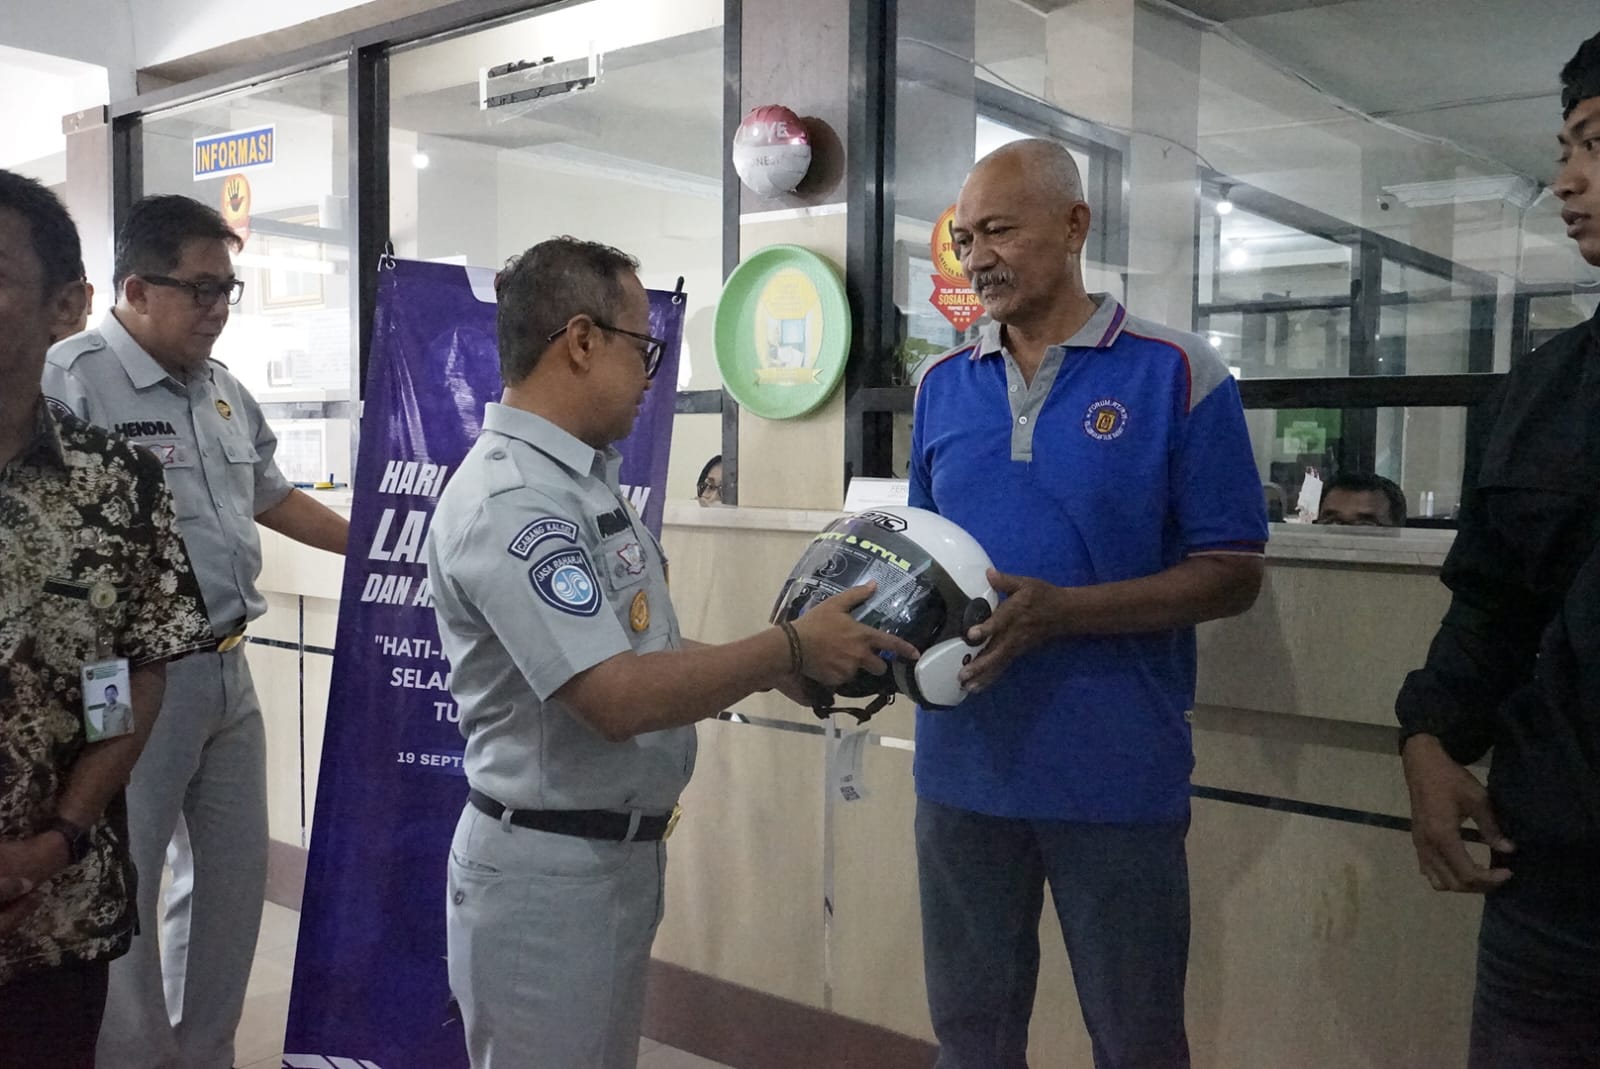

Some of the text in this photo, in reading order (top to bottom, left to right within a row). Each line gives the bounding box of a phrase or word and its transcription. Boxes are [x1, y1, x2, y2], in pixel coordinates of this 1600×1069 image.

[197, 133, 272, 172] INFORMASI
[1088, 399, 1111, 413] FORUM
[115, 421, 176, 438] HENDRA
[378, 460, 448, 497] HARI
[517, 525, 545, 551] CABANG
[859, 540, 911, 572] STYLE
[536, 564, 555, 582] JASA
[360, 573, 435, 608] DAN A
[433, 701, 461, 723] TU
[397, 752, 464, 768] 19 SEPT
